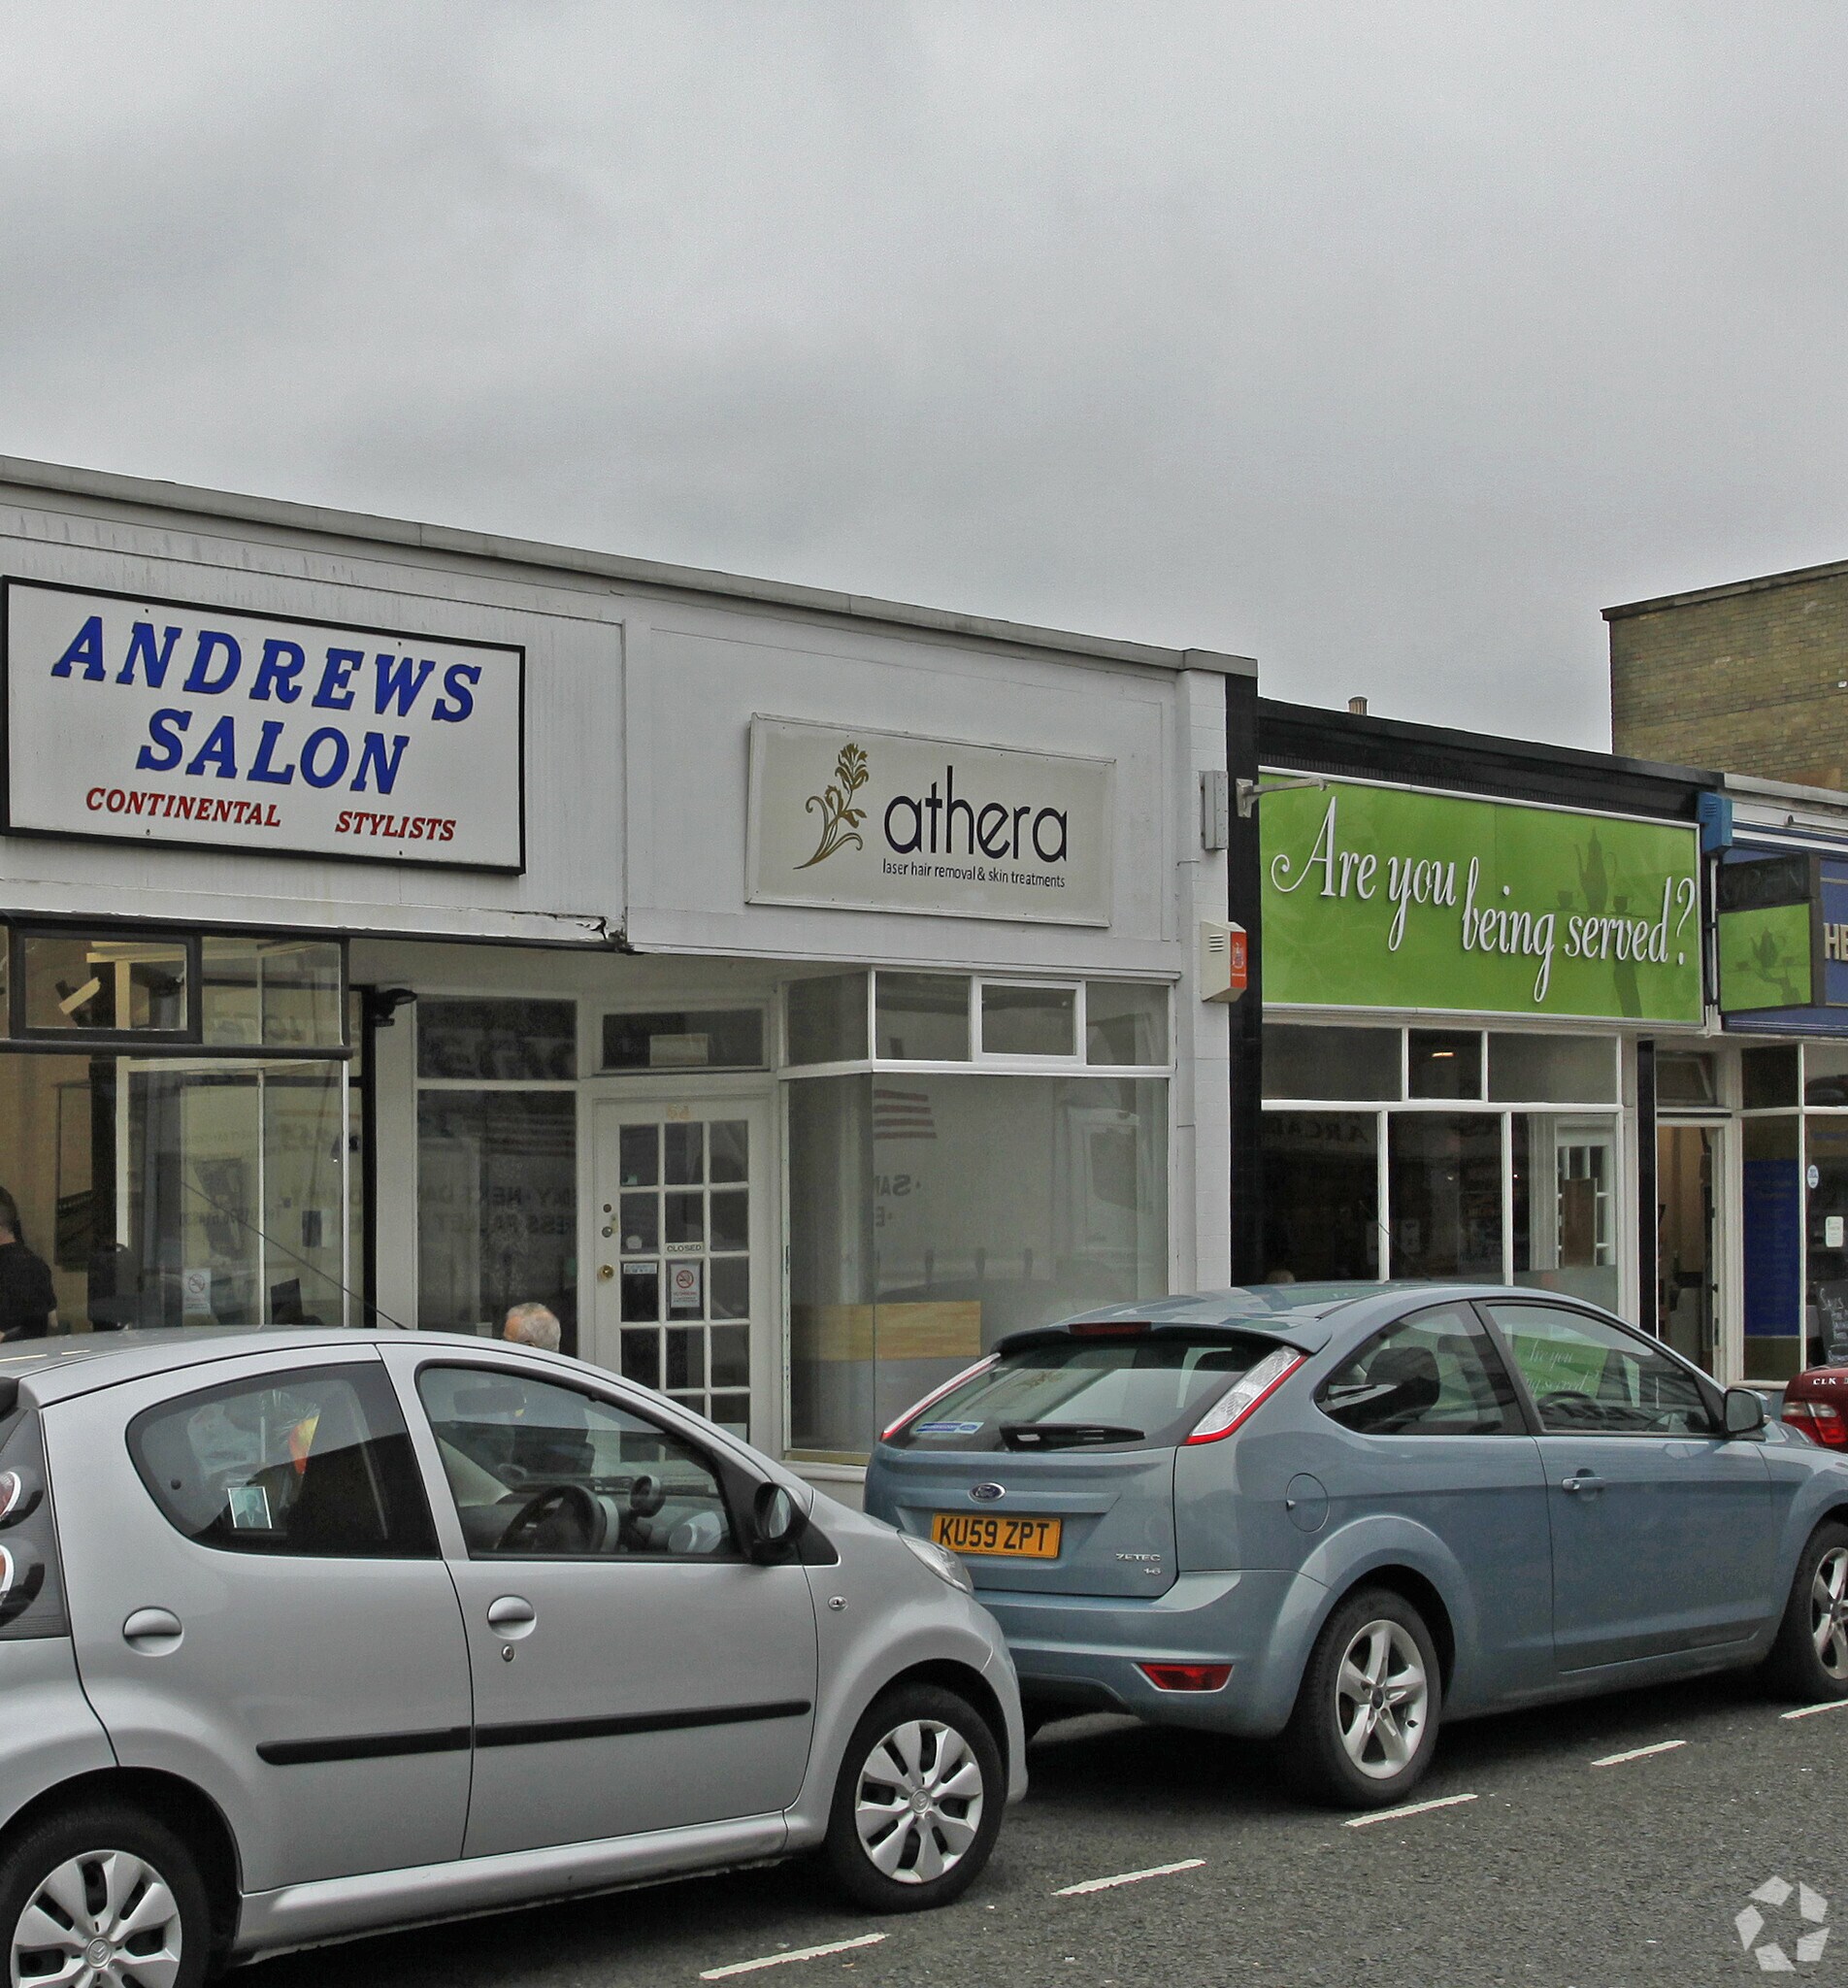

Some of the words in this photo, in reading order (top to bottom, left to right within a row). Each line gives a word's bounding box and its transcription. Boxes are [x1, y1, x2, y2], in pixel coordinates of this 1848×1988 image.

[51, 615, 481, 722] ANDREWS
[136, 708, 410, 795] SALON
[86, 787, 281, 828] CONTINENTAL
[335, 811, 456, 842] STYLISTS
[884, 765, 1068, 863] athera
[882, 858, 908, 877] laser
[910, 860, 932, 878] hair
[935, 864, 975, 881] removal
[977, 868, 986, 881] &
[988, 867, 1008, 883] skin
[1010, 870, 1066, 888] treatments
[1270, 796, 1377, 899] Are
[1387, 855, 1457, 952] you
[1463, 855, 1555, 1003] being
[1564, 876, 1697, 966] served?
[666, 1243, 702, 1252] CLOSED
[1812, 1376, 1837, 1386] CLK
[939, 1517, 999, 1548] KU59
[1003, 1520, 1050, 1552] ZPT
[1115, 1552, 1162, 1562] ZETEC
